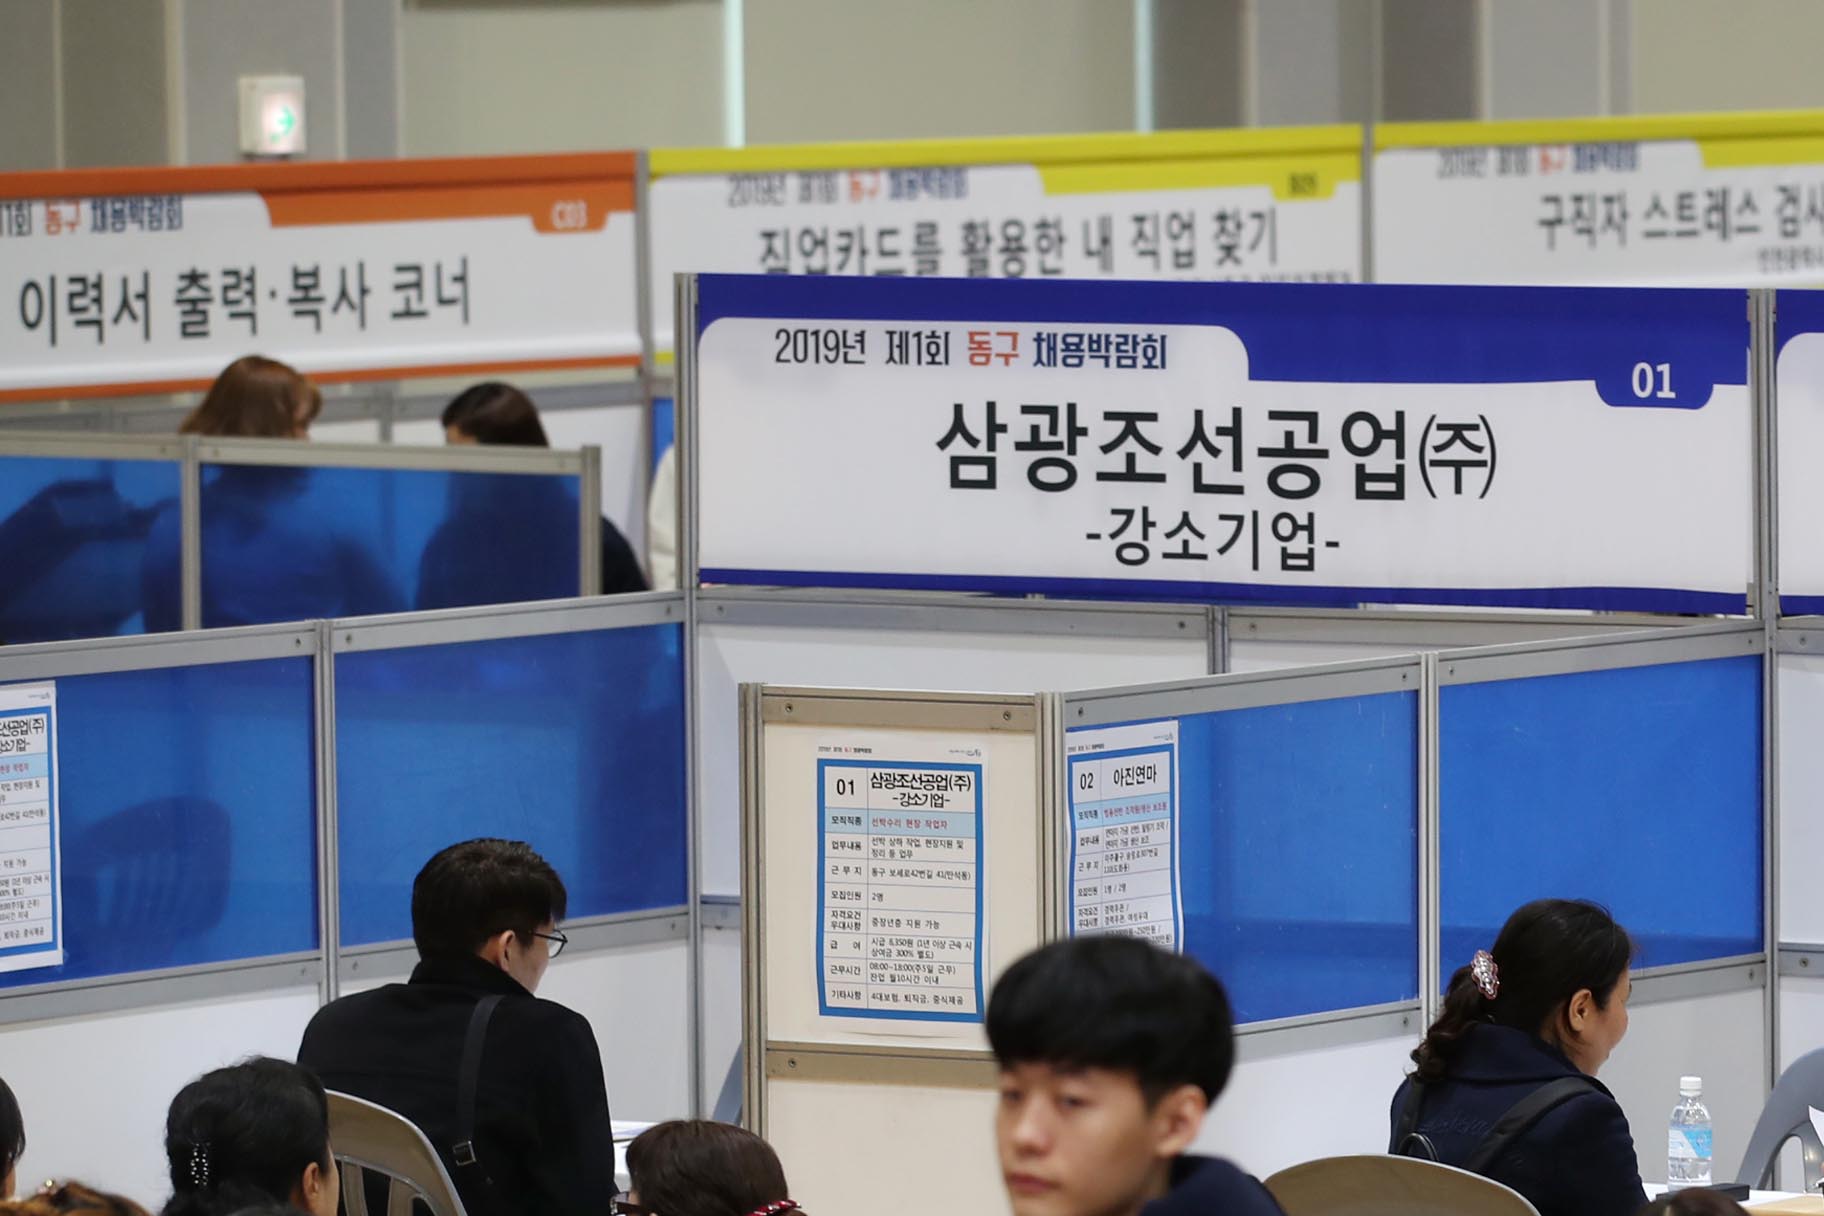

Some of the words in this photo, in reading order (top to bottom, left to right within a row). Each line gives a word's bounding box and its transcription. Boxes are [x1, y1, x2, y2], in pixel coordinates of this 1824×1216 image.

[1537, 190, 1630, 252] 구직자
[1643, 186, 1762, 242] 스트레스
[960, 213, 1067, 278] 활용한
[1082, 213, 1114, 273] 내
[1130, 209, 1196, 271] 직업
[1213, 204, 1278, 268] 찾기
[19, 268, 151, 347] 이력서
[391, 254, 471, 326] 코너
[774, 329, 868, 367] 2019년
[884, 329, 951, 368] 제1회
[967, 331, 1021, 369] 동구
[1033, 332, 1168, 371] 채용박람회
[1631, 362, 1677, 400] 01
[836, 779, 855, 796] 01
[870, 772, 972, 792] 삼광조선공업(주)
[1079, 772, 1094, 790] 02
[1113, 764, 1157, 787] 아진연마
[831, 840, 862, 851] 업무내용
[831, 890, 862, 901] 모집인원
[830, 964, 861, 976] 근무시간
